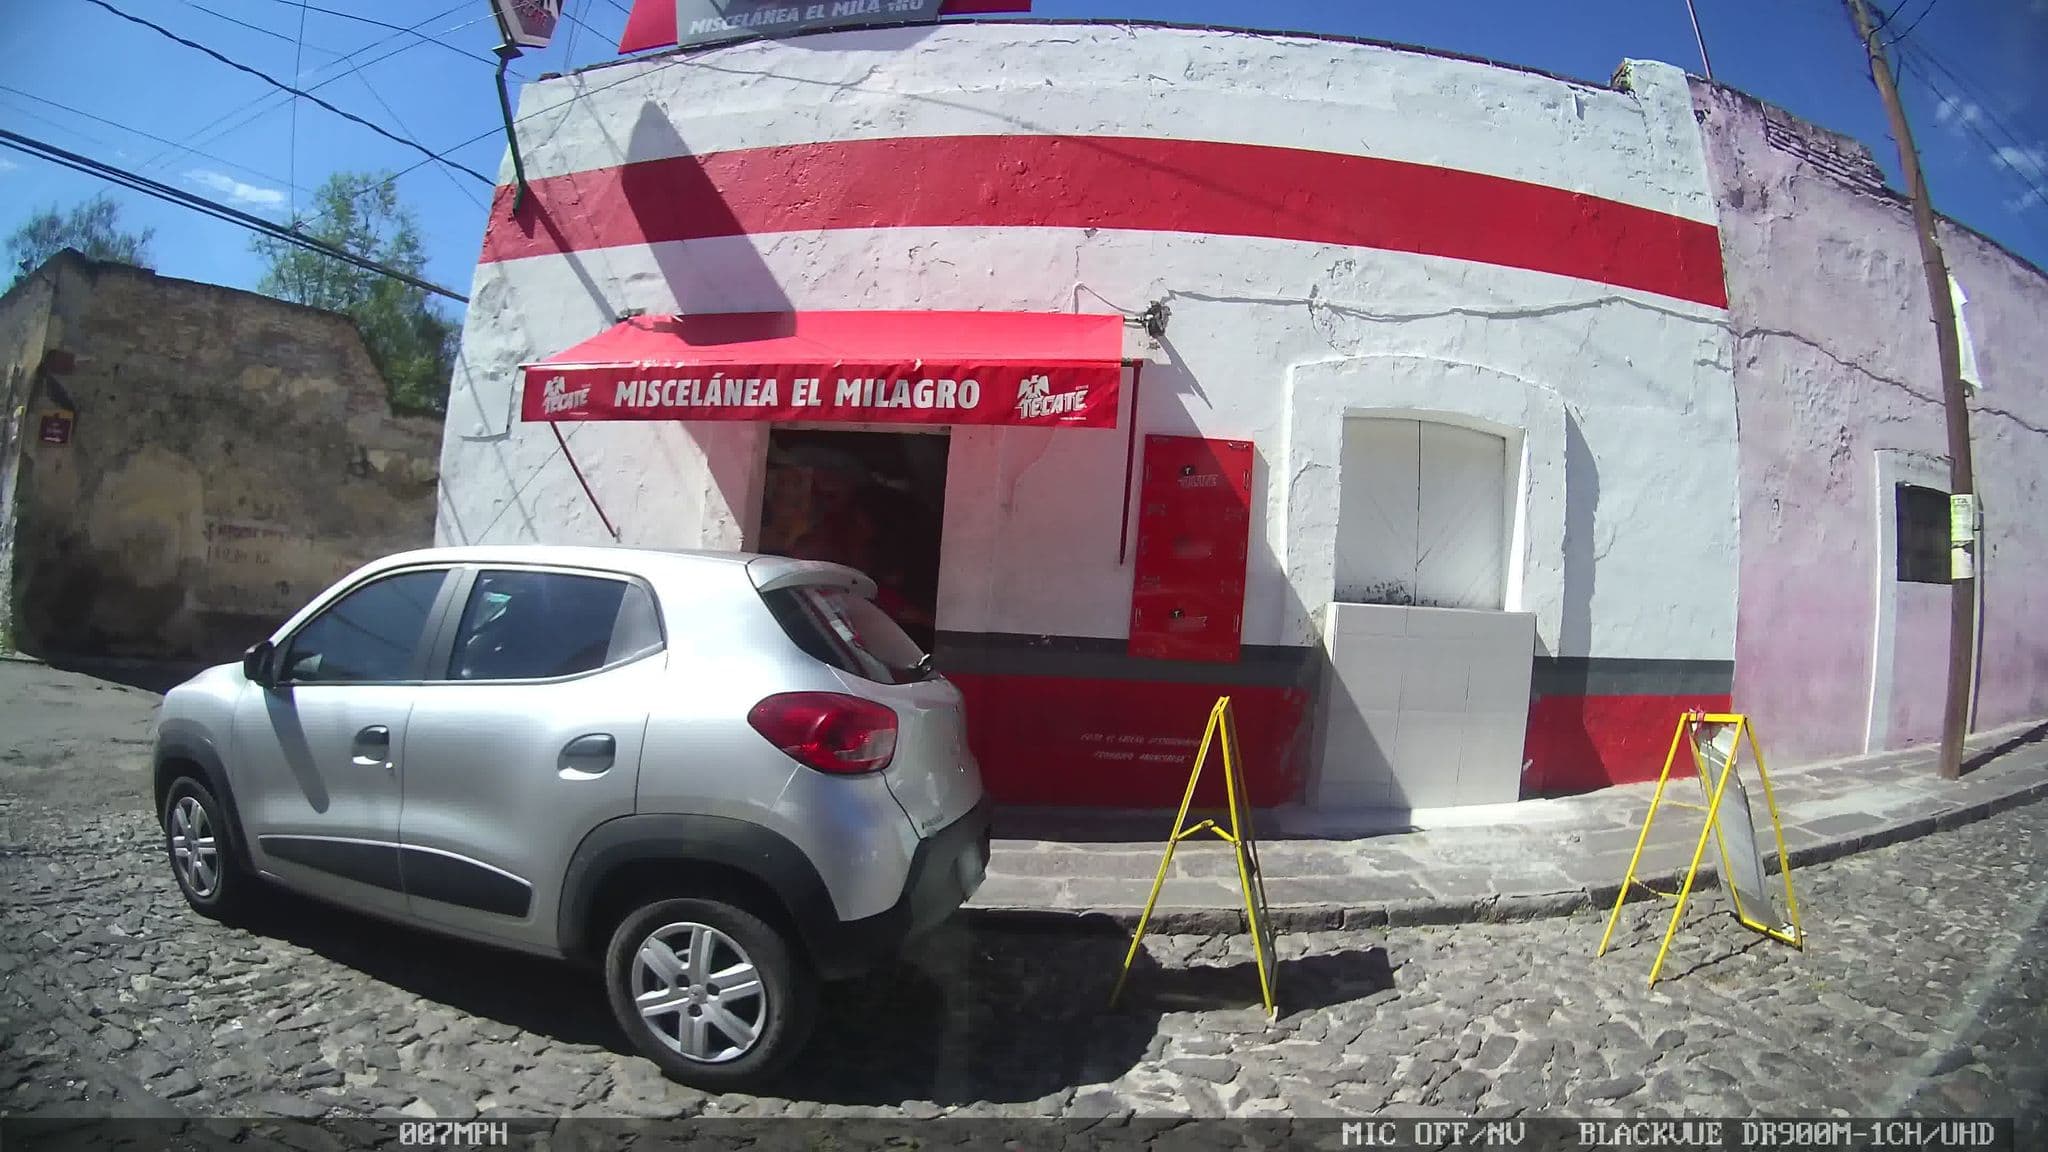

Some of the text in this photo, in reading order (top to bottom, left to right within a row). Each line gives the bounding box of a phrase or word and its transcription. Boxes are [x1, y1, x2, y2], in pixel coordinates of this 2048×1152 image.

[688, 7, 800, 35] MISCELÁNEA
[806, 4, 825, 20] EL
[542, 387, 592, 415] TECATE
[614, 371, 981, 409] MISCELÁNEA EL MILAGRO
[1015, 389, 1089, 420] TECATE
